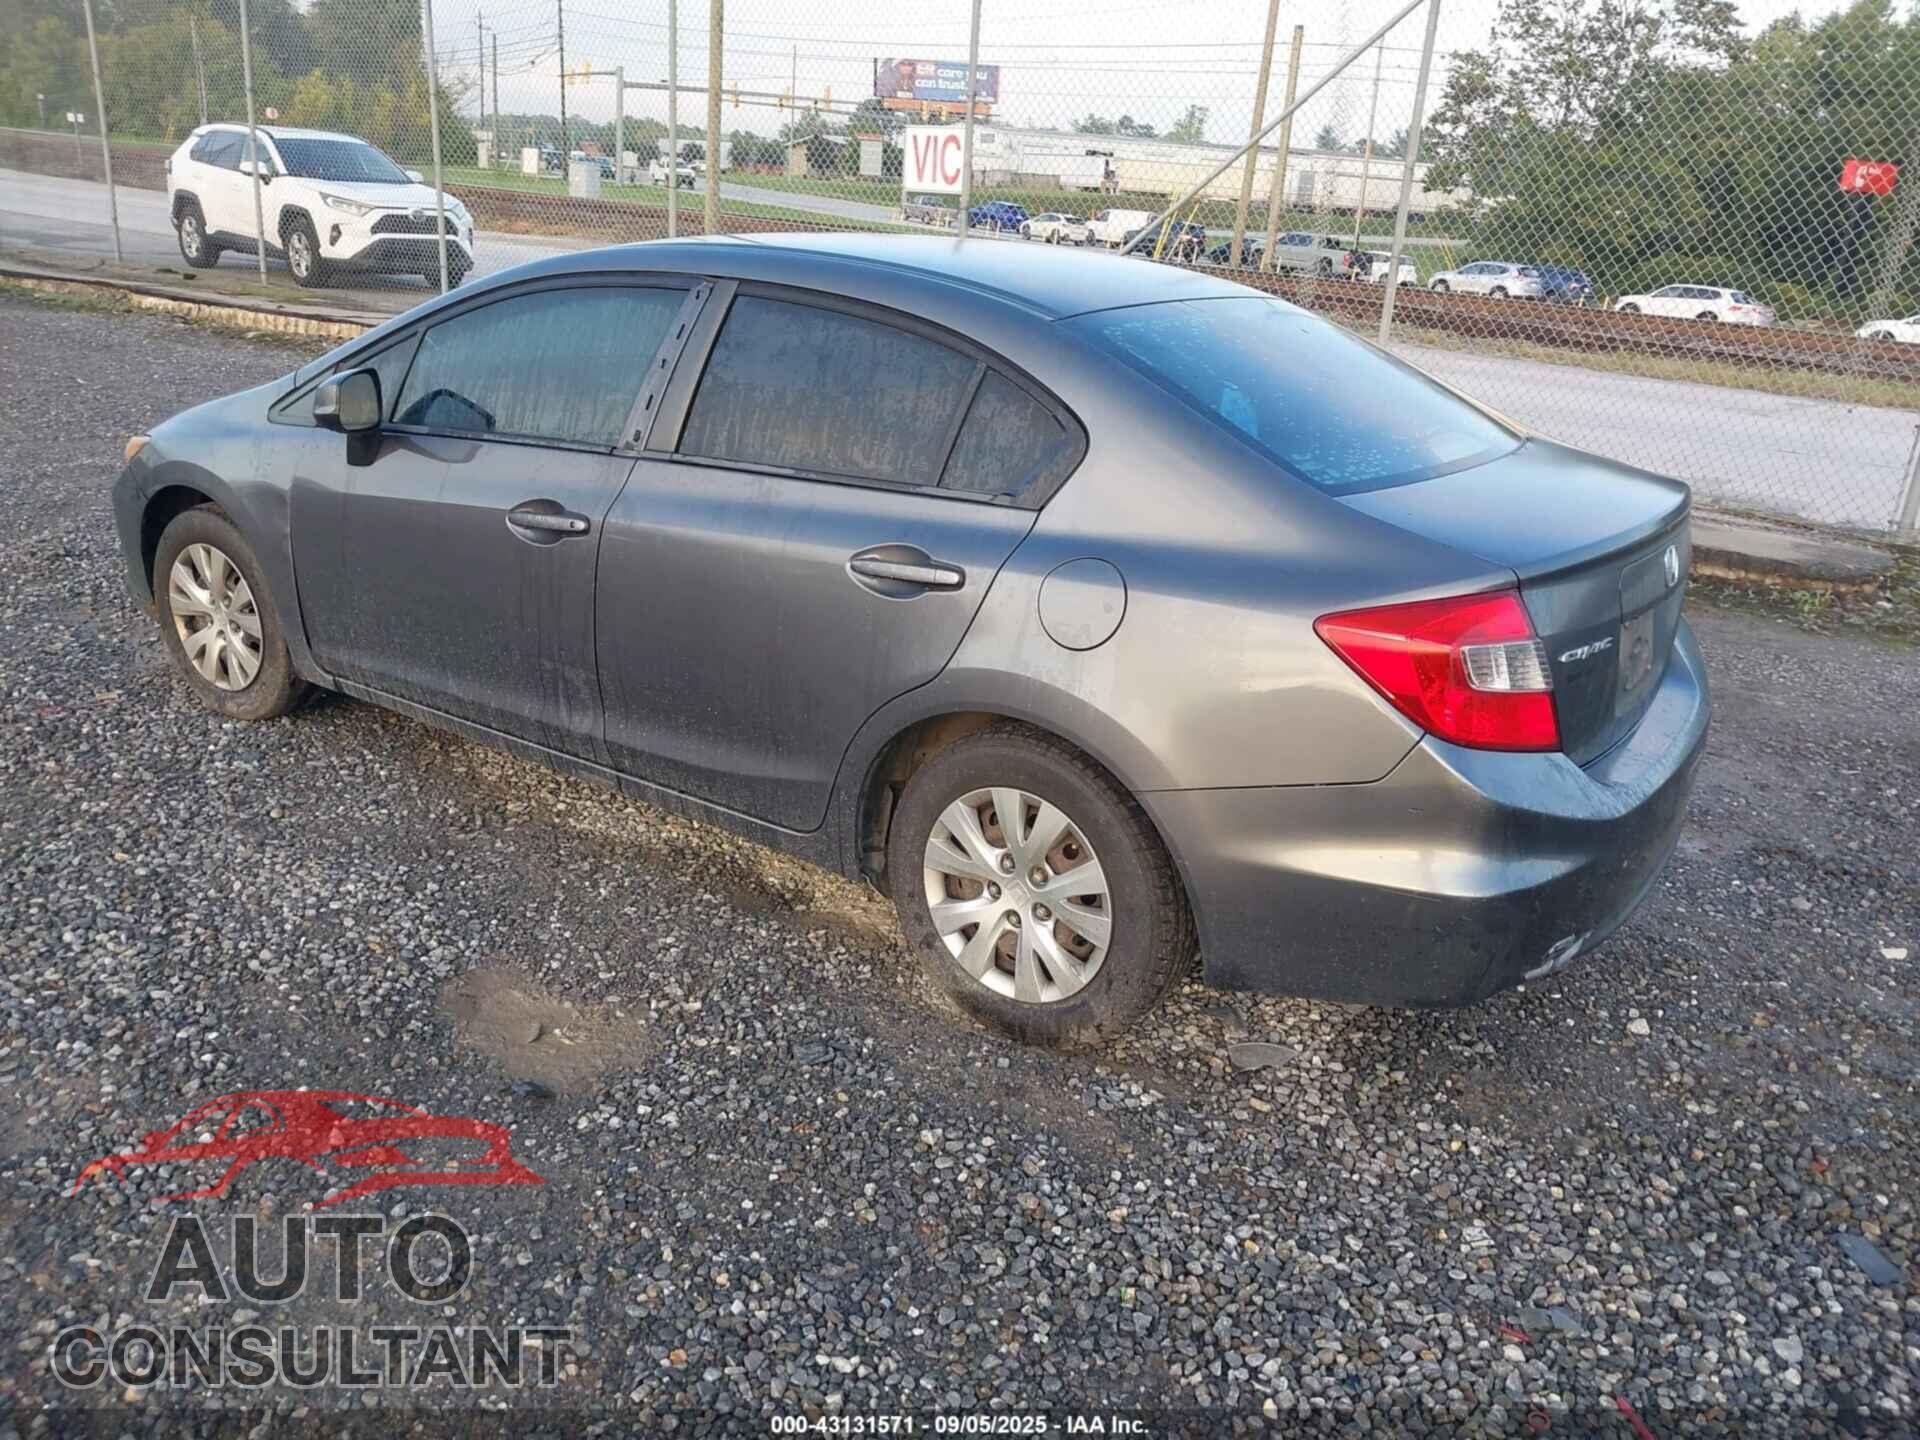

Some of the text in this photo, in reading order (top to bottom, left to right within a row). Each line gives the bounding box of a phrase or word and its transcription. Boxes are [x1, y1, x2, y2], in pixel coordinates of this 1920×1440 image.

[937, 69, 964, 79] care
[914, 78, 937, 88] can
[912, 134, 961, 186] VIC
